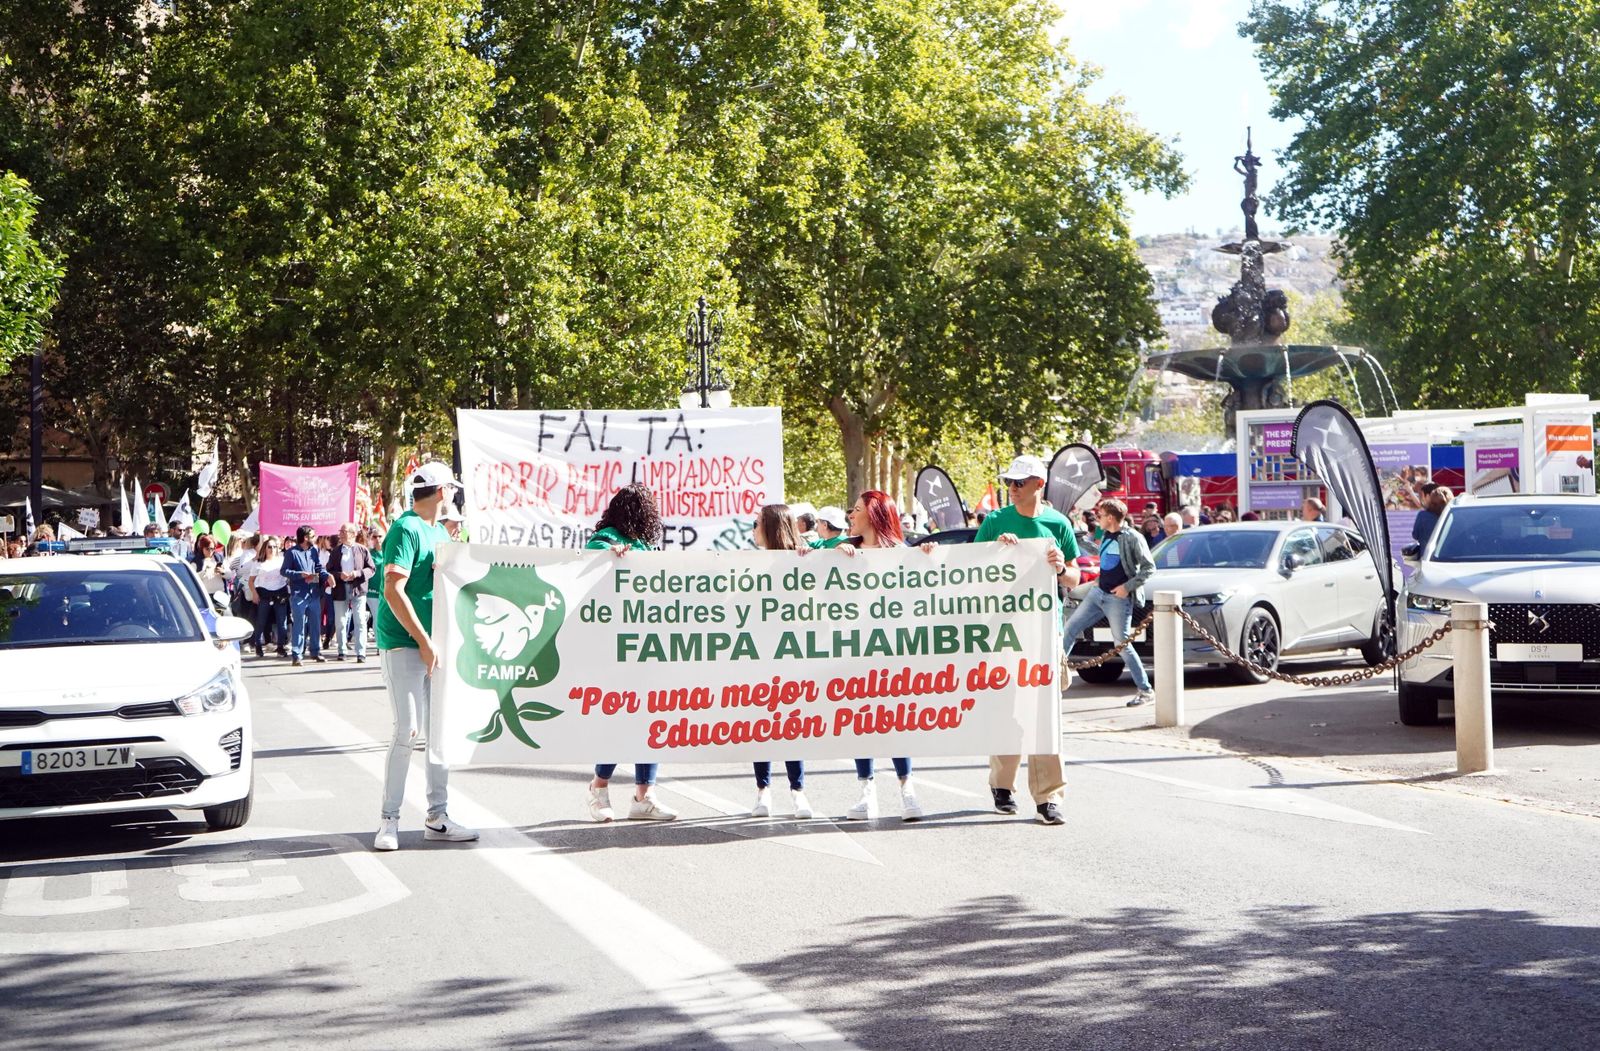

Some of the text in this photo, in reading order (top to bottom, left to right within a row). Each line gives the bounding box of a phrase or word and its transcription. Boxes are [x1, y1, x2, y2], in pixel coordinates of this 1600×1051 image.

[1265, 429, 1293, 439] THE SPA
[1265, 440, 1292, 448] PRESID
[1379, 455, 1400, 463] country
[615, 563, 1018, 594] Federación de Asociaciones
[580, 588, 1053, 629] de Madres y Padres de alumnado
[616, 622, 1023, 663] FAMPA ALHAMBRA
[1530, 645, 1542, 653] DS
[476, 664, 539, 682] FAMPA
[647, 683, 715, 714] una
[720, 675, 820, 713] mejor
[825, 663, 960, 702] calidad
[966, 660, 1012, 692] de
[1017, 657, 1053, 689] la
[647, 708, 827, 750] Educación
[37, 747, 131, 771] 8203 LZW
